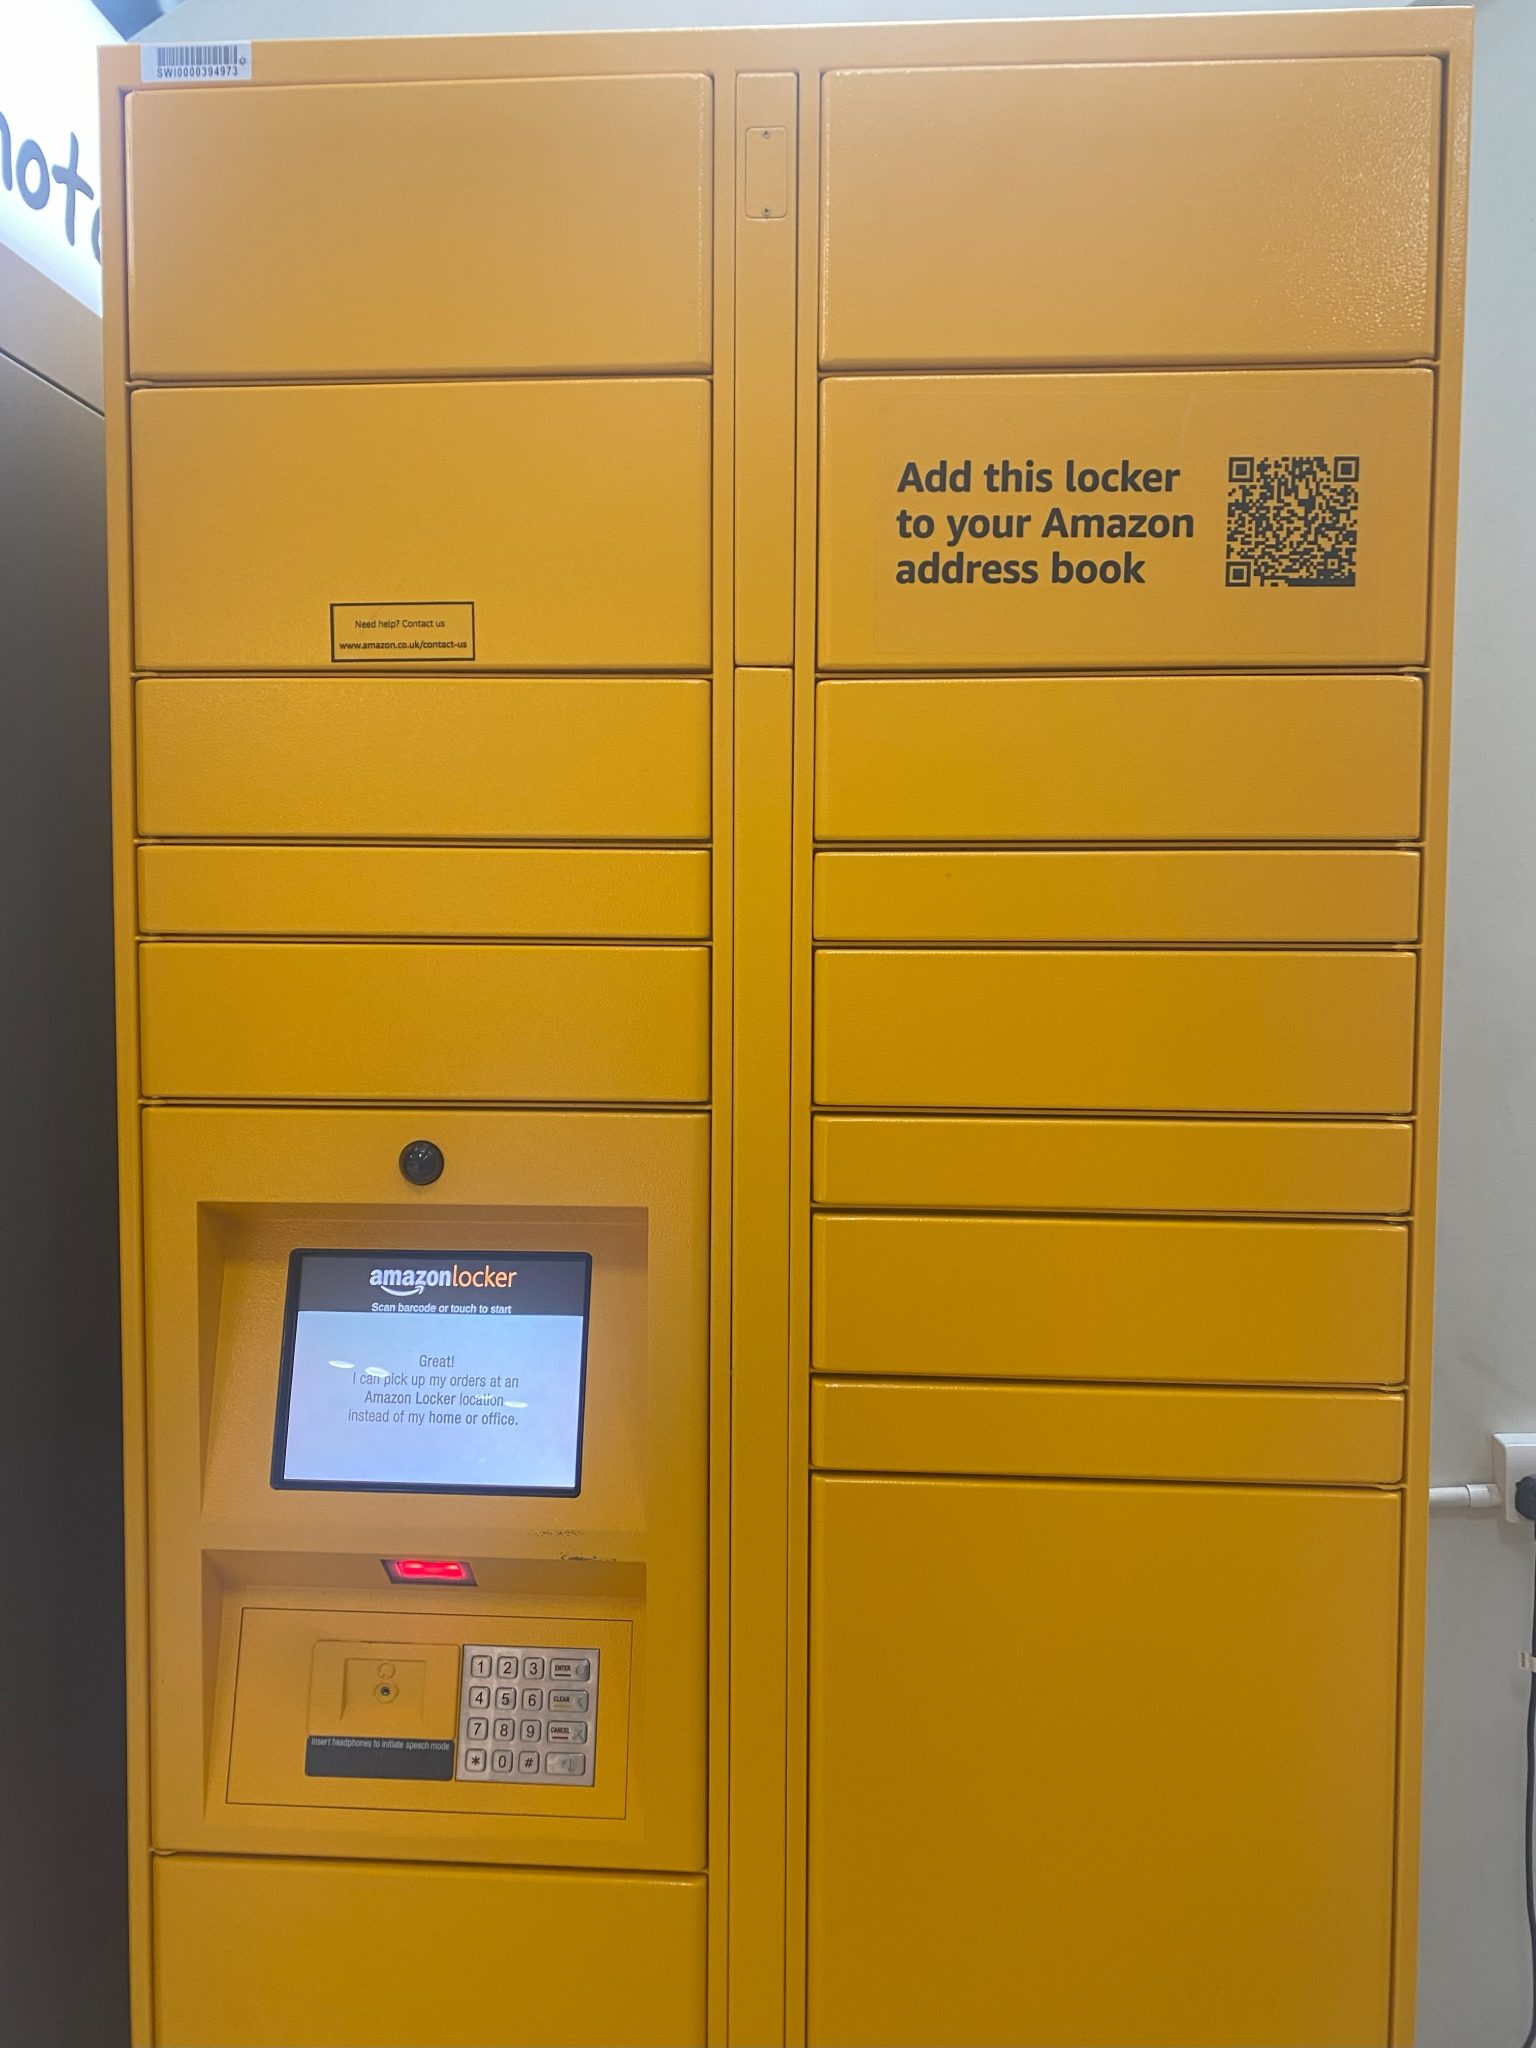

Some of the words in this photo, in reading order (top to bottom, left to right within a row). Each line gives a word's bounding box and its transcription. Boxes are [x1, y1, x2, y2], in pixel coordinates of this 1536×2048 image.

[156, 66, 239, 79] SWI0000394973
[896, 460, 972, 492] Add
[984, 460, 1053, 492] this
[1066, 460, 1181, 492] locker
[896, 510, 935, 538] to
[946, 514, 1032, 547] your
[1041, 508, 1194, 538] Amazon
[896, 552, 1038, 584] address
[1051, 552, 1145, 584] book
[355, 620, 376, 628] Need
[378, 620, 400, 629] help?
[402, 619, 434, 628] Contact
[339, 640, 468, 650] www.amazon.co.uk/contact-us
[371, 1302, 396, 1312] Scan
[397, 1302, 436, 1313] barcode
[438, 1305, 449, 1313] or
[450, 1303, 477, 1314] touch
[478, 1304, 488, 1314] to
[490, 1304, 512, 1314] start
[418, 1354, 455, 1368] Great!
[352, 1372, 356, 1385] I
[359, 1375, 380, 1386] can
[384, 1372, 408, 1388] pick
[411, 1376, 426, 1388] up
[429, 1376, 446, 1389] my
[449, 1373, 486, 1388] orders
[489, 1376, 502, 1388] at
[504, 1378, 519, 1389] an
[364, 1391, 412, 1404] Amazon
[415, 1392, 456, 1406] Locker
[459, 1392, 504, 1407] location
[348, 1409, 389, 1423] instead
[392, 1410, 406, 1423] of
[408, 1413, 426, 1426] my
[428, 1411, 462, 1425] home
[466, 1415, 478, 1425] or
[481, 1412, 518, 1426] office.
[478, 1661, 483, 1673] 1
[504, 1662, 512, 1674] 2
[530, 1662, 538, 1675] 3
[475, 1692, 483, 1705] 4
[502, 1692, 510, 1706] 5
[528, 1694, 536, 1706] 6
[474, 1723, 482, 1736] 7
[500, 1724, 508, 1737] 8
[526, 1725, 534, 1738] 9
[312, 1737, 331, 1746] Insert
[332, 1738, 372, 1749] headphones
[382, 1740, 404, 1749] initiate
[406, 1742, 430, 1751] speech
[430, 1742, 450, 1751] mode
